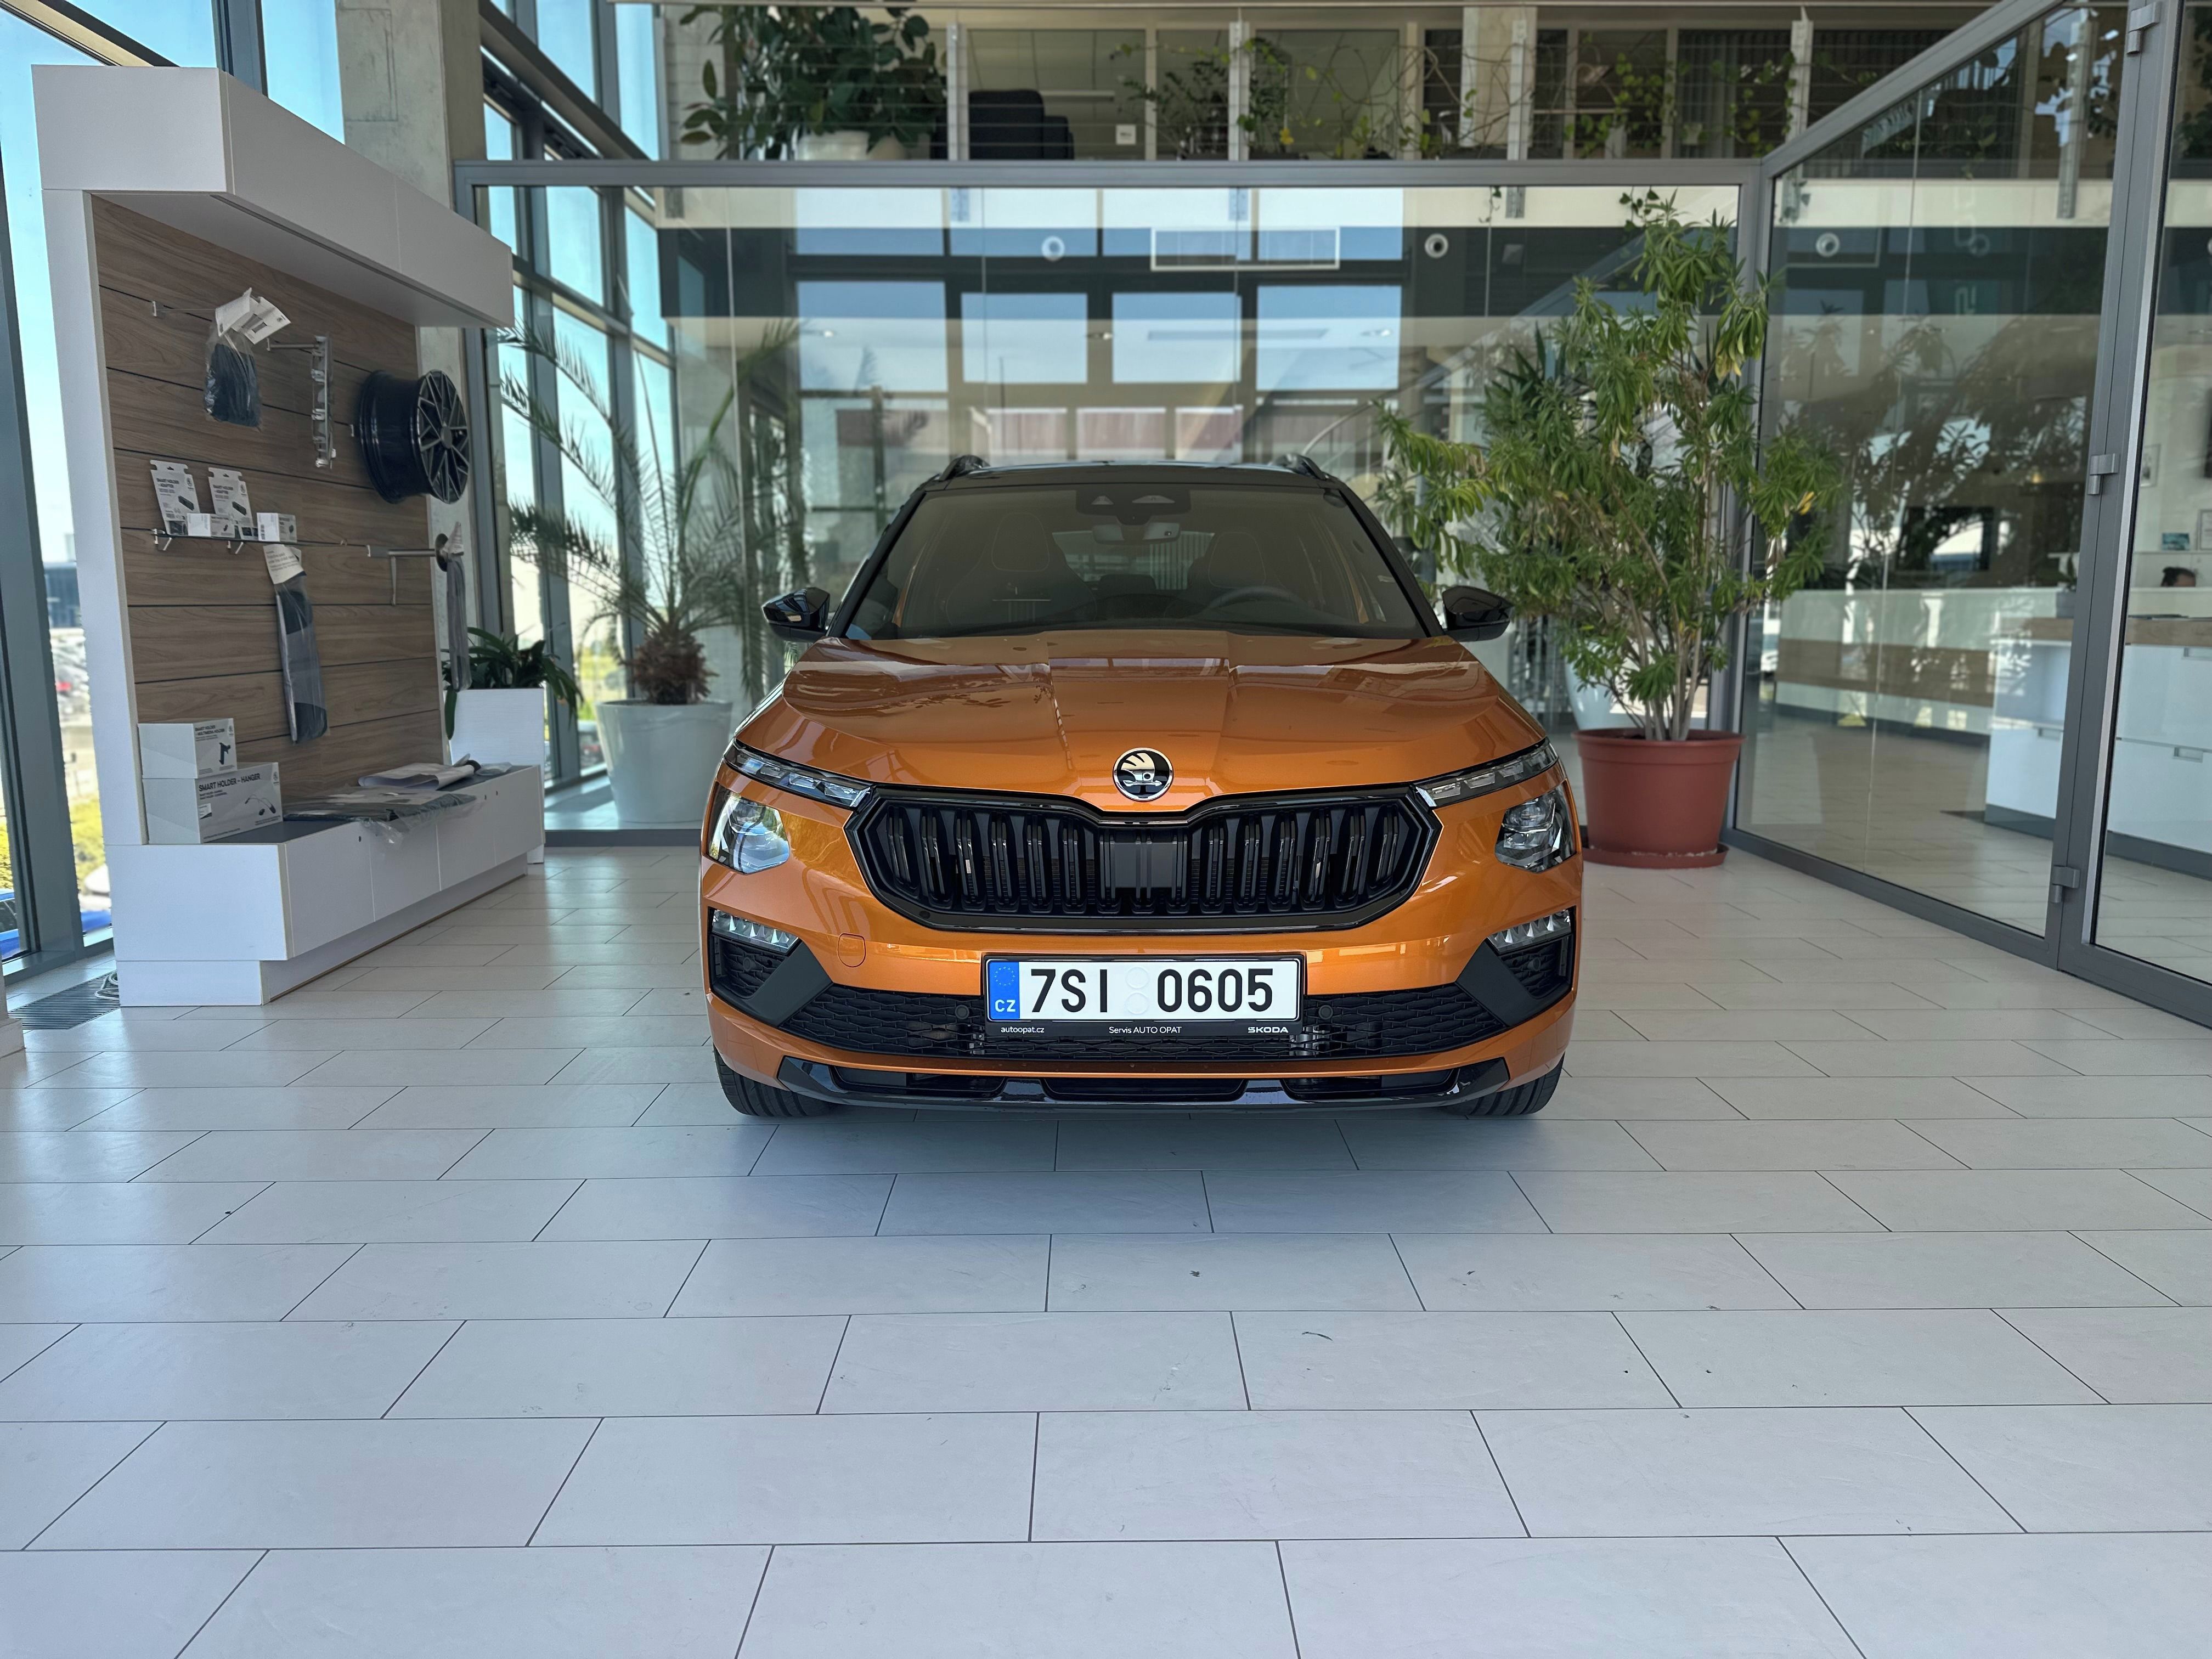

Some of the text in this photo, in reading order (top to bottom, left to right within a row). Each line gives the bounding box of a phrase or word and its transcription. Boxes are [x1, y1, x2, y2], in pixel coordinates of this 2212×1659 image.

[199, 782, 217, 792] SMART
[217, 778, 238, 788] HOLDER
[241, 773, 261, 783] HANGER
[1031, 969, 1273, 1013] 7SI 0605
[995, 999, 1016, 1012] CZ
[1001, 1026, 1045, 1034] autoopat.cz
